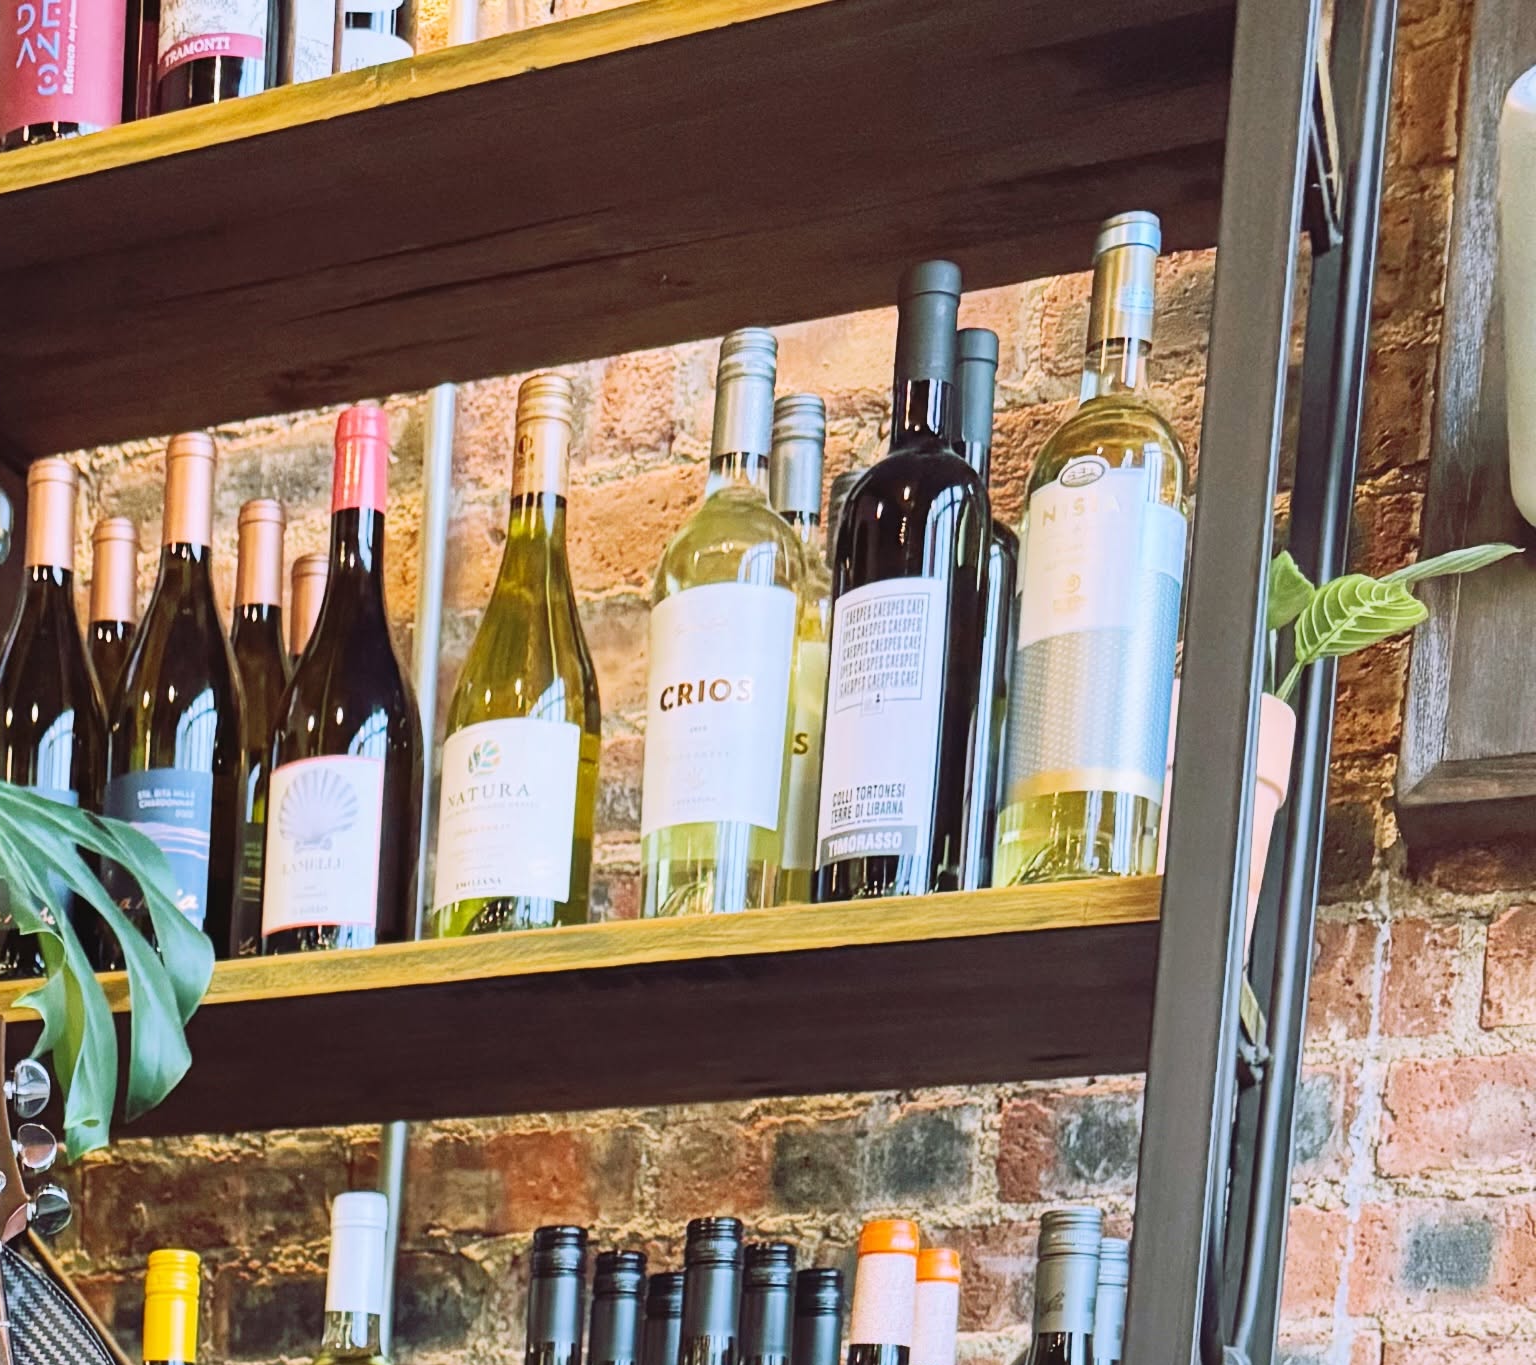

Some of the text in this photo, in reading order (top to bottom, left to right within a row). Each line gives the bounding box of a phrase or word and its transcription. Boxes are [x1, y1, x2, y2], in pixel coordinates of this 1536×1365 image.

[164, 36, 231, 68] TRAMONTI
[660, 678, 752, 712] CRIOS
[447, 783, 531, 809] NATURA
[832, 784, 905, 807] COLLI TORTONESI
[830, 806, 852, 824] TERRE
[855, 803, 864, 818] DI
[867, 800, 903, 816] LIBARNA
[828, 832, 903, 858] TIMORASSO
